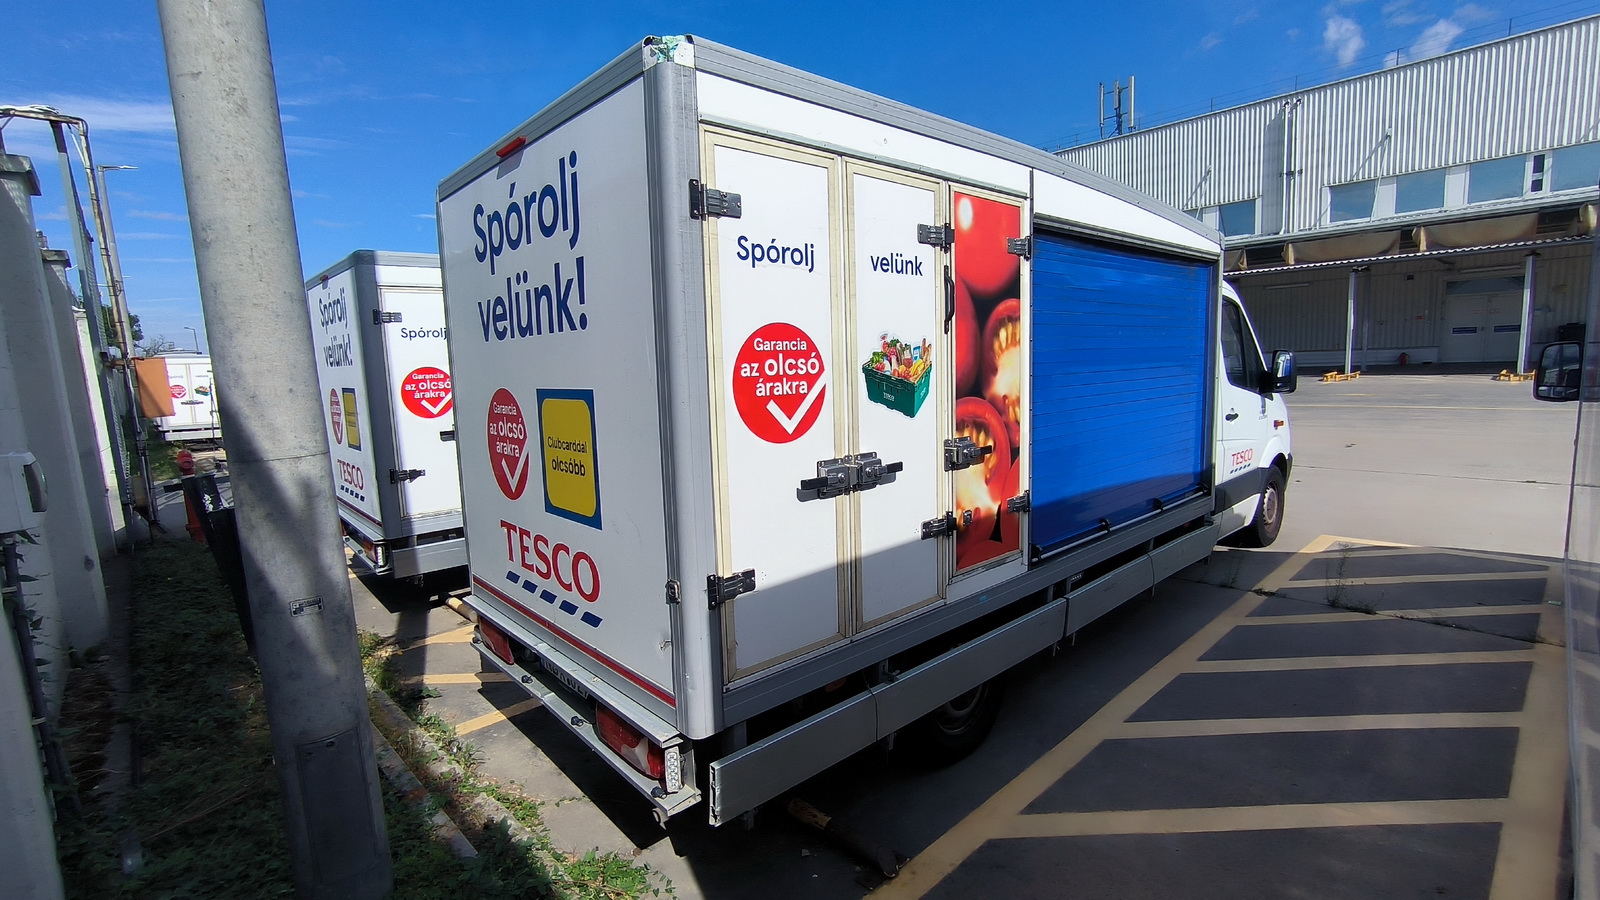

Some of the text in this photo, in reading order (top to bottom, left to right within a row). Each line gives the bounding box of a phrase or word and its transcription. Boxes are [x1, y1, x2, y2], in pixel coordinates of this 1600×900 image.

[473, 150, 580, 274] Spórolj
[736, 235, 923, 277] Spórolj velünk
[319, 287, 347, 333] Spórolj
[478, 256, 588, 343] velünk!
[401, 327, 447, 341] Spórolj
[753, 337, 807, 351] Garancia
[323, 333, 353, 367] velünk!
[740, 352, 820, 378] az olcsó
[414, 389, 445, 399] árakra
[419, 379, 451, 390] olcsó
[755, 378, 808, 397] árakra
[493, 402, 517, 416] Garancia
[489, 417, 525, 442] az olcsó
[496, 440, 519, 457] árakra
[548, 436, 587, 454] Clubcarddal
[551, 456, 586, 477] olcsóbb
[1232, 448, 1253, 466] TESCO
[337, 459, 364, 491] TESCO
[500, 520, 601, 603] TESCO
